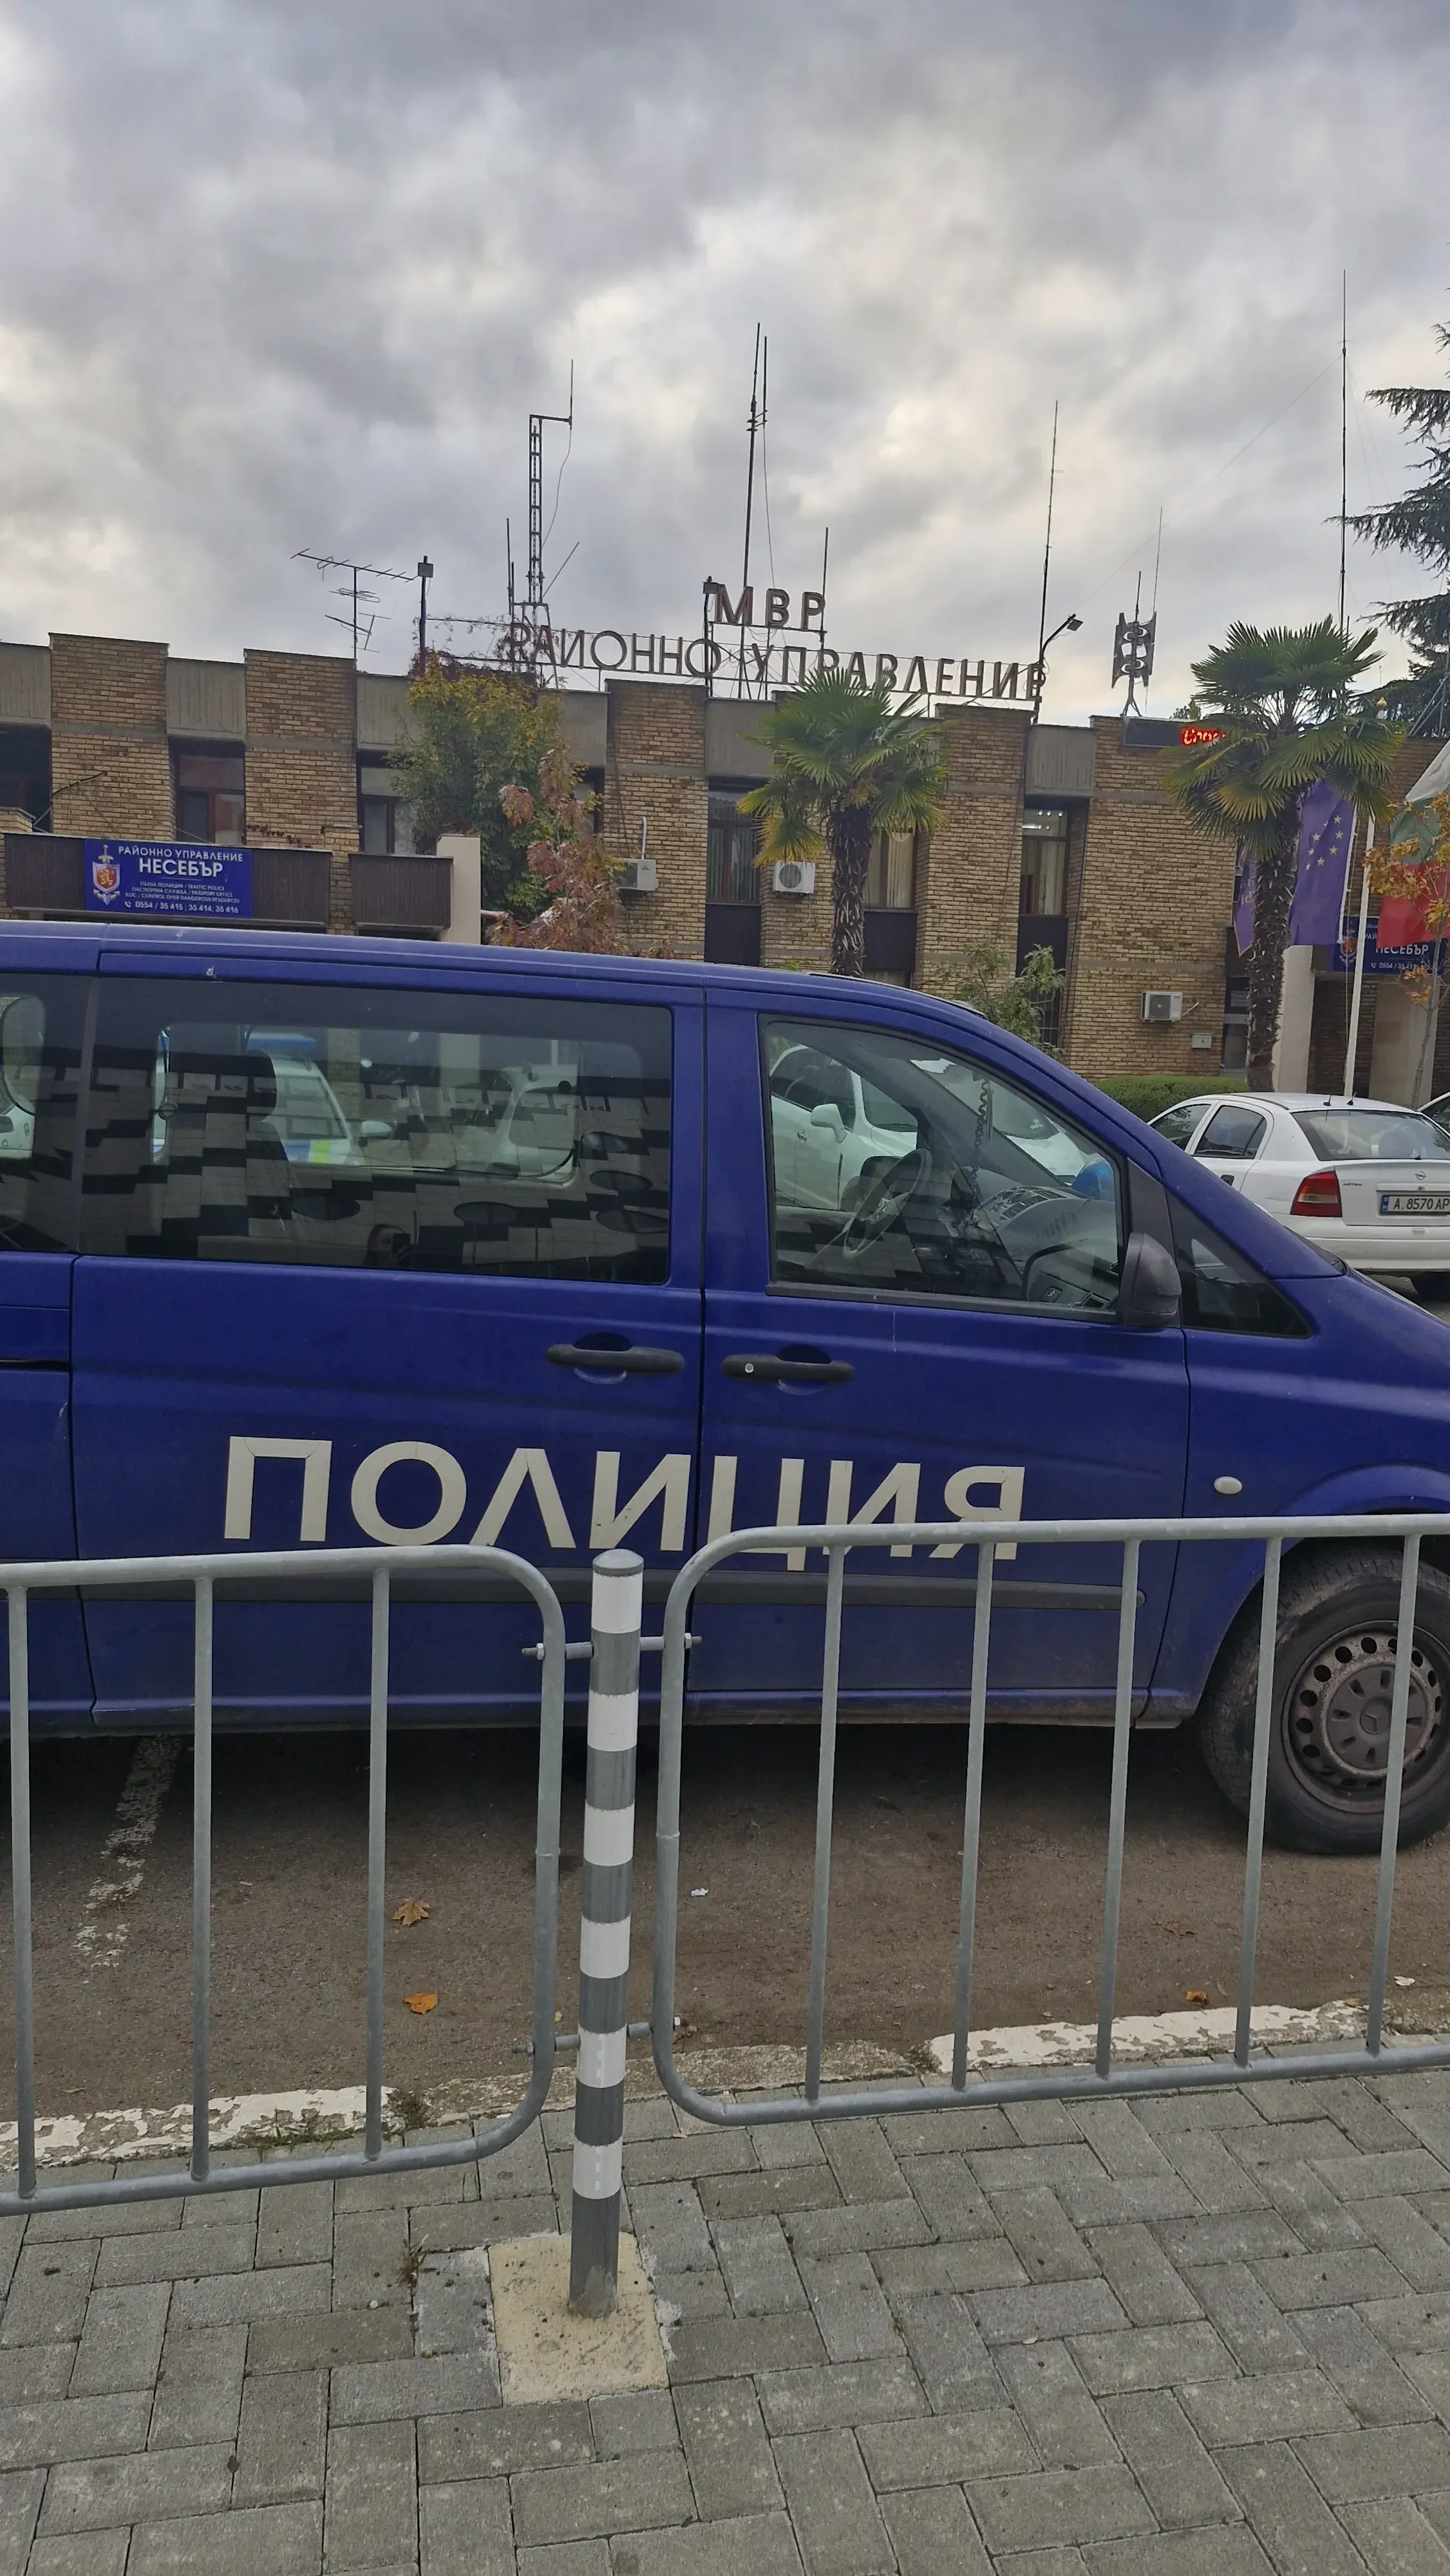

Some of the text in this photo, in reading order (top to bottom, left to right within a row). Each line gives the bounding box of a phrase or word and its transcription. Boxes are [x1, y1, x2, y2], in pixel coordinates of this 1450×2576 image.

[715, 583, 825, 630] МВР
[118, 845, 243, 862] РАЙОННО УПРАВЛЕНИЕ
[139, 857, 223, 877] НЕСЕБЪР
[1406, 1197, 1434, 1210] 8570
[224, 1436, 1025, 1571] ПОЛИЦИЯ
